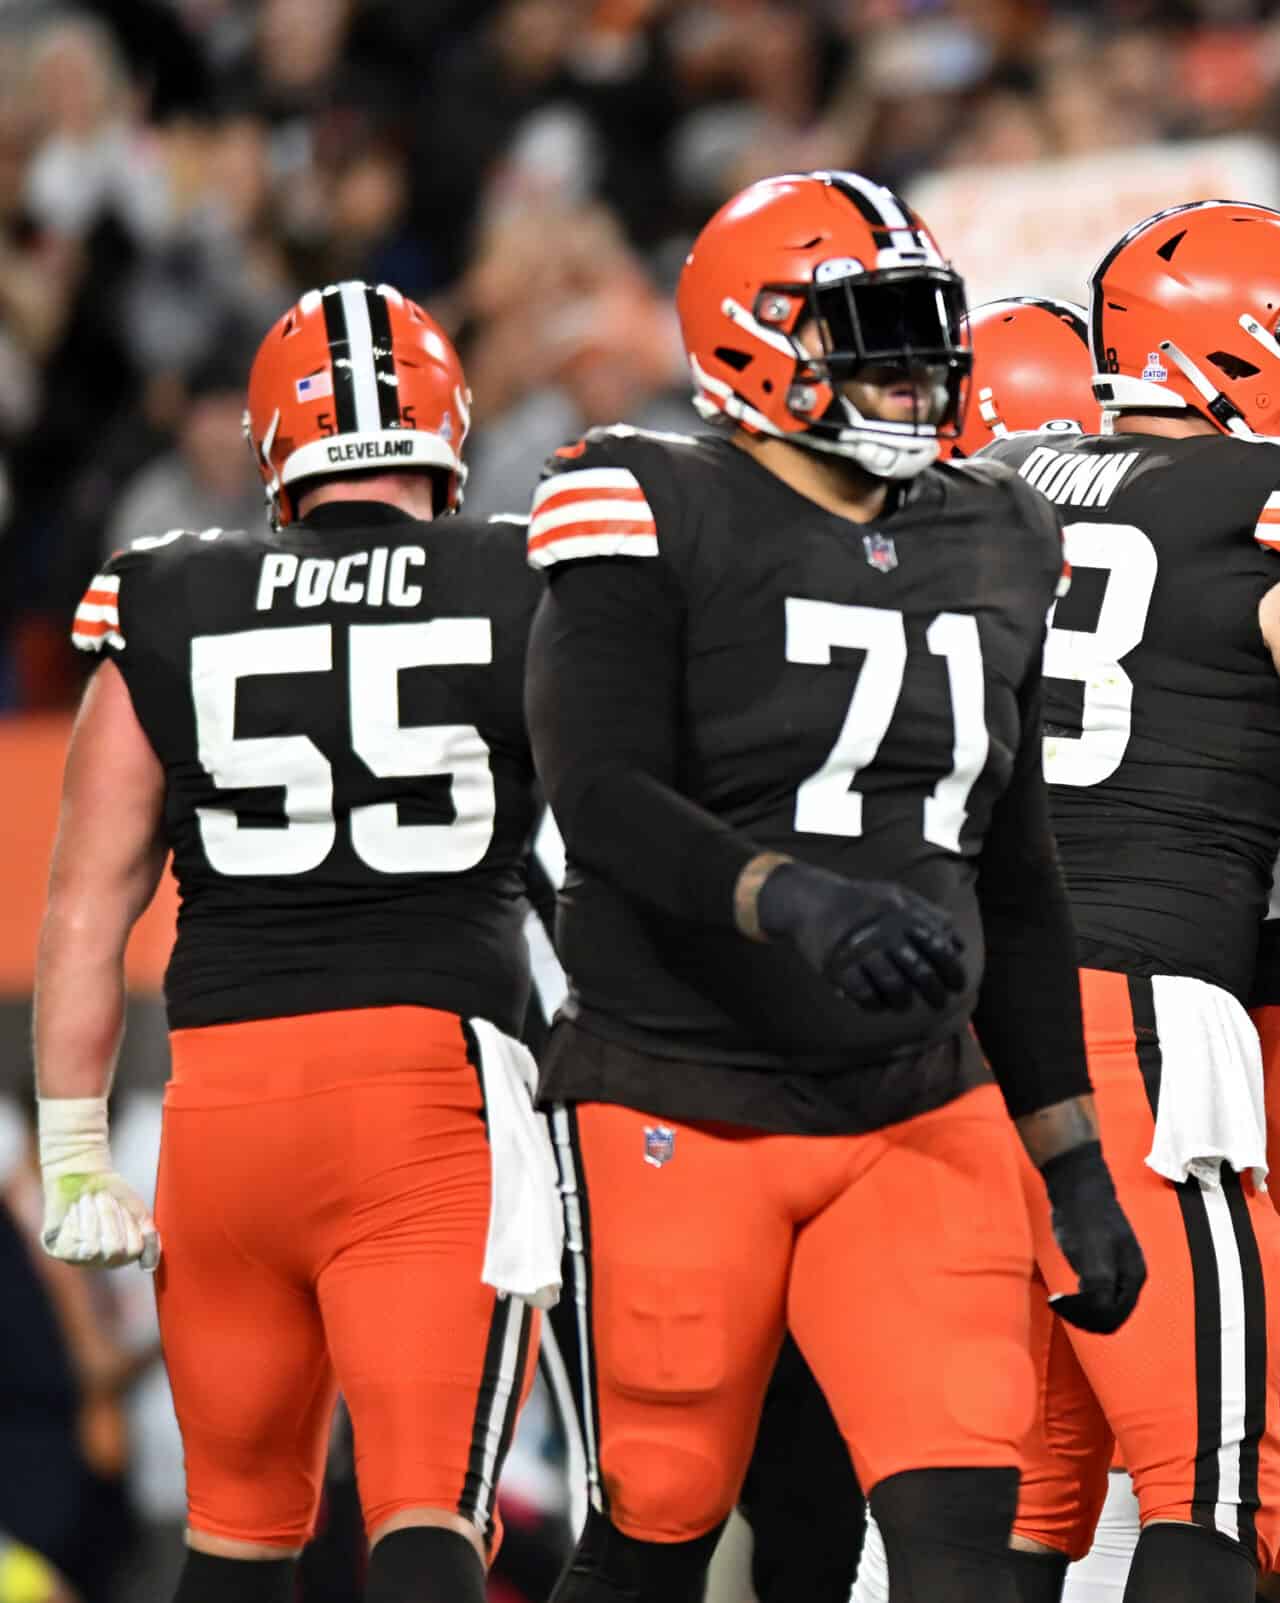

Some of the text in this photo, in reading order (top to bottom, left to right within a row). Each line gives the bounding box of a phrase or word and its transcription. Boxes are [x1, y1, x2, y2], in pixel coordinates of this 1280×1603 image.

[326, 438, 415, 463] CLEVELAND
[1017, 445, 1141, 508] DUNN
[255, 545, 427, 612] POCIC
[190, 617, 497, 877] 55
[785, 596, 990, 854] 71
